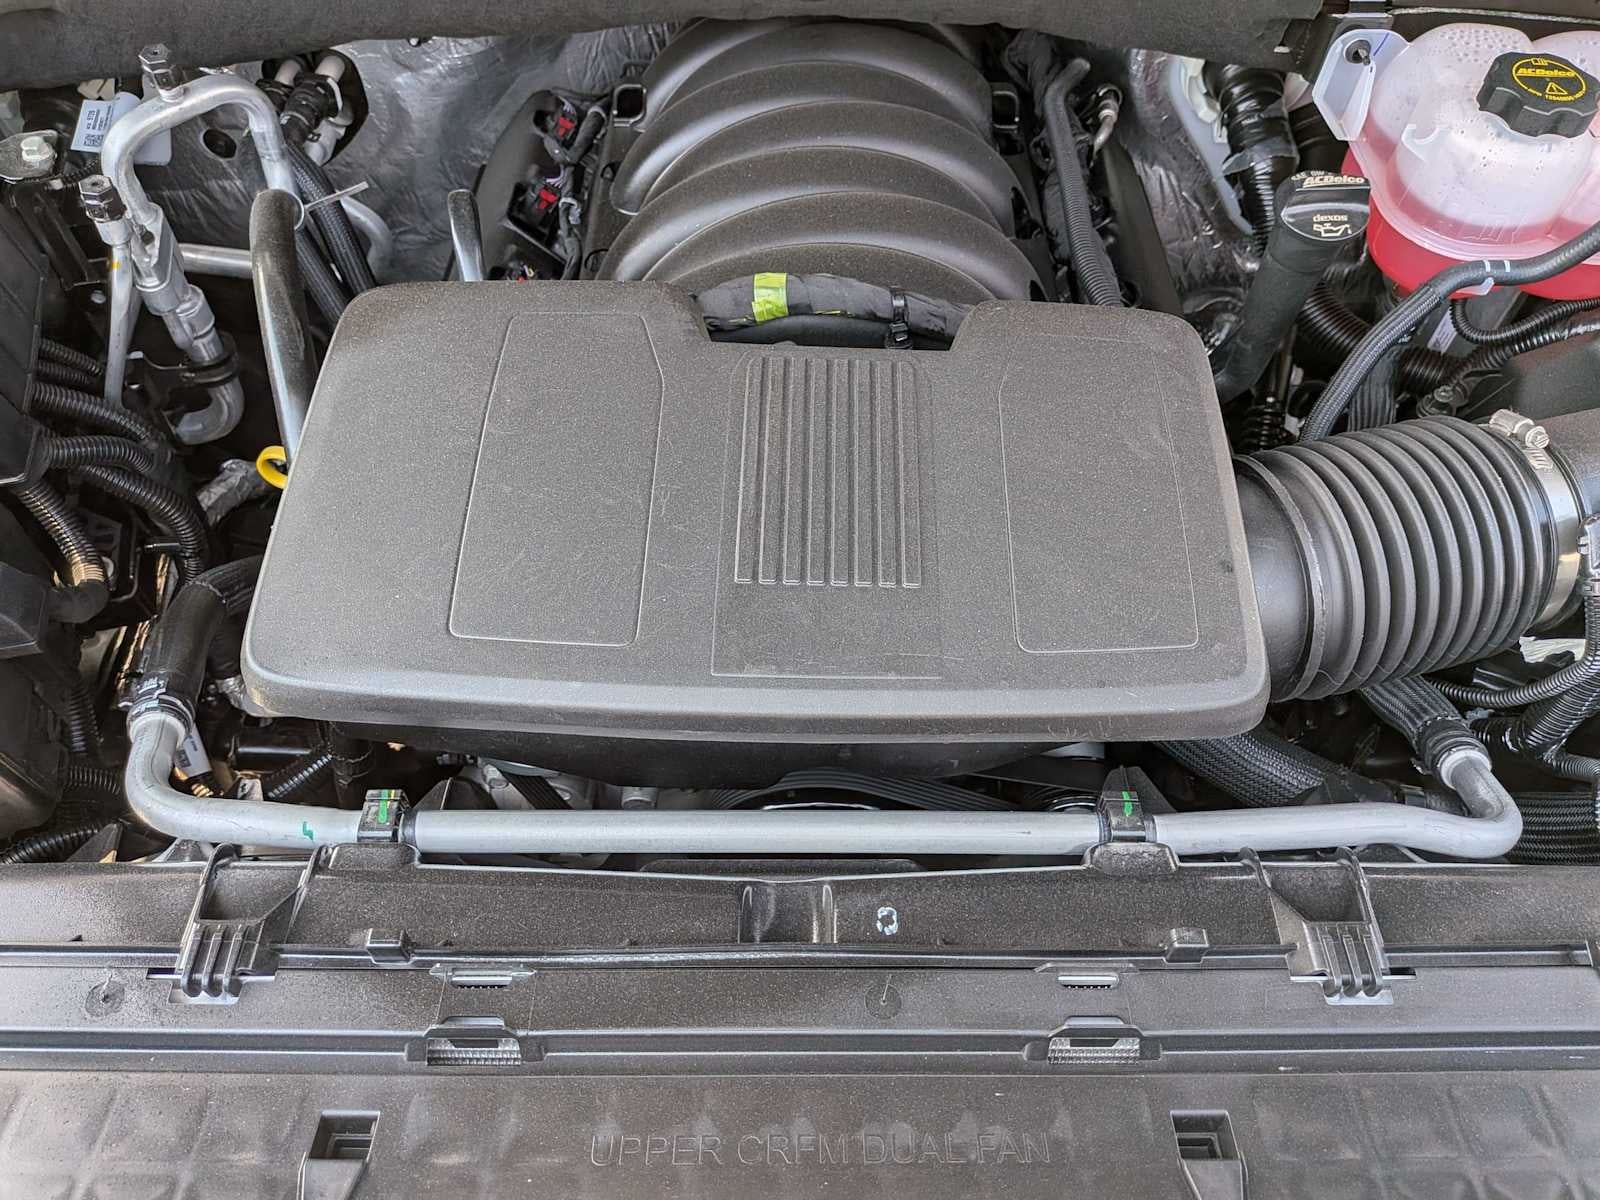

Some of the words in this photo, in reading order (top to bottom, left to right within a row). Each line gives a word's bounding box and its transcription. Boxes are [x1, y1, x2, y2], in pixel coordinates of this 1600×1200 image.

[1303, 175, 1365, 188] ACDelco
[1313, 214, 1349, 223] dexos
[591, 1134, 725, 1167] UPPER
[737, 1133, 849, 1165] CRFM
[862, 1131, 968, 1165] DUAL
[976, 1131, 1051, 1164] FAN
